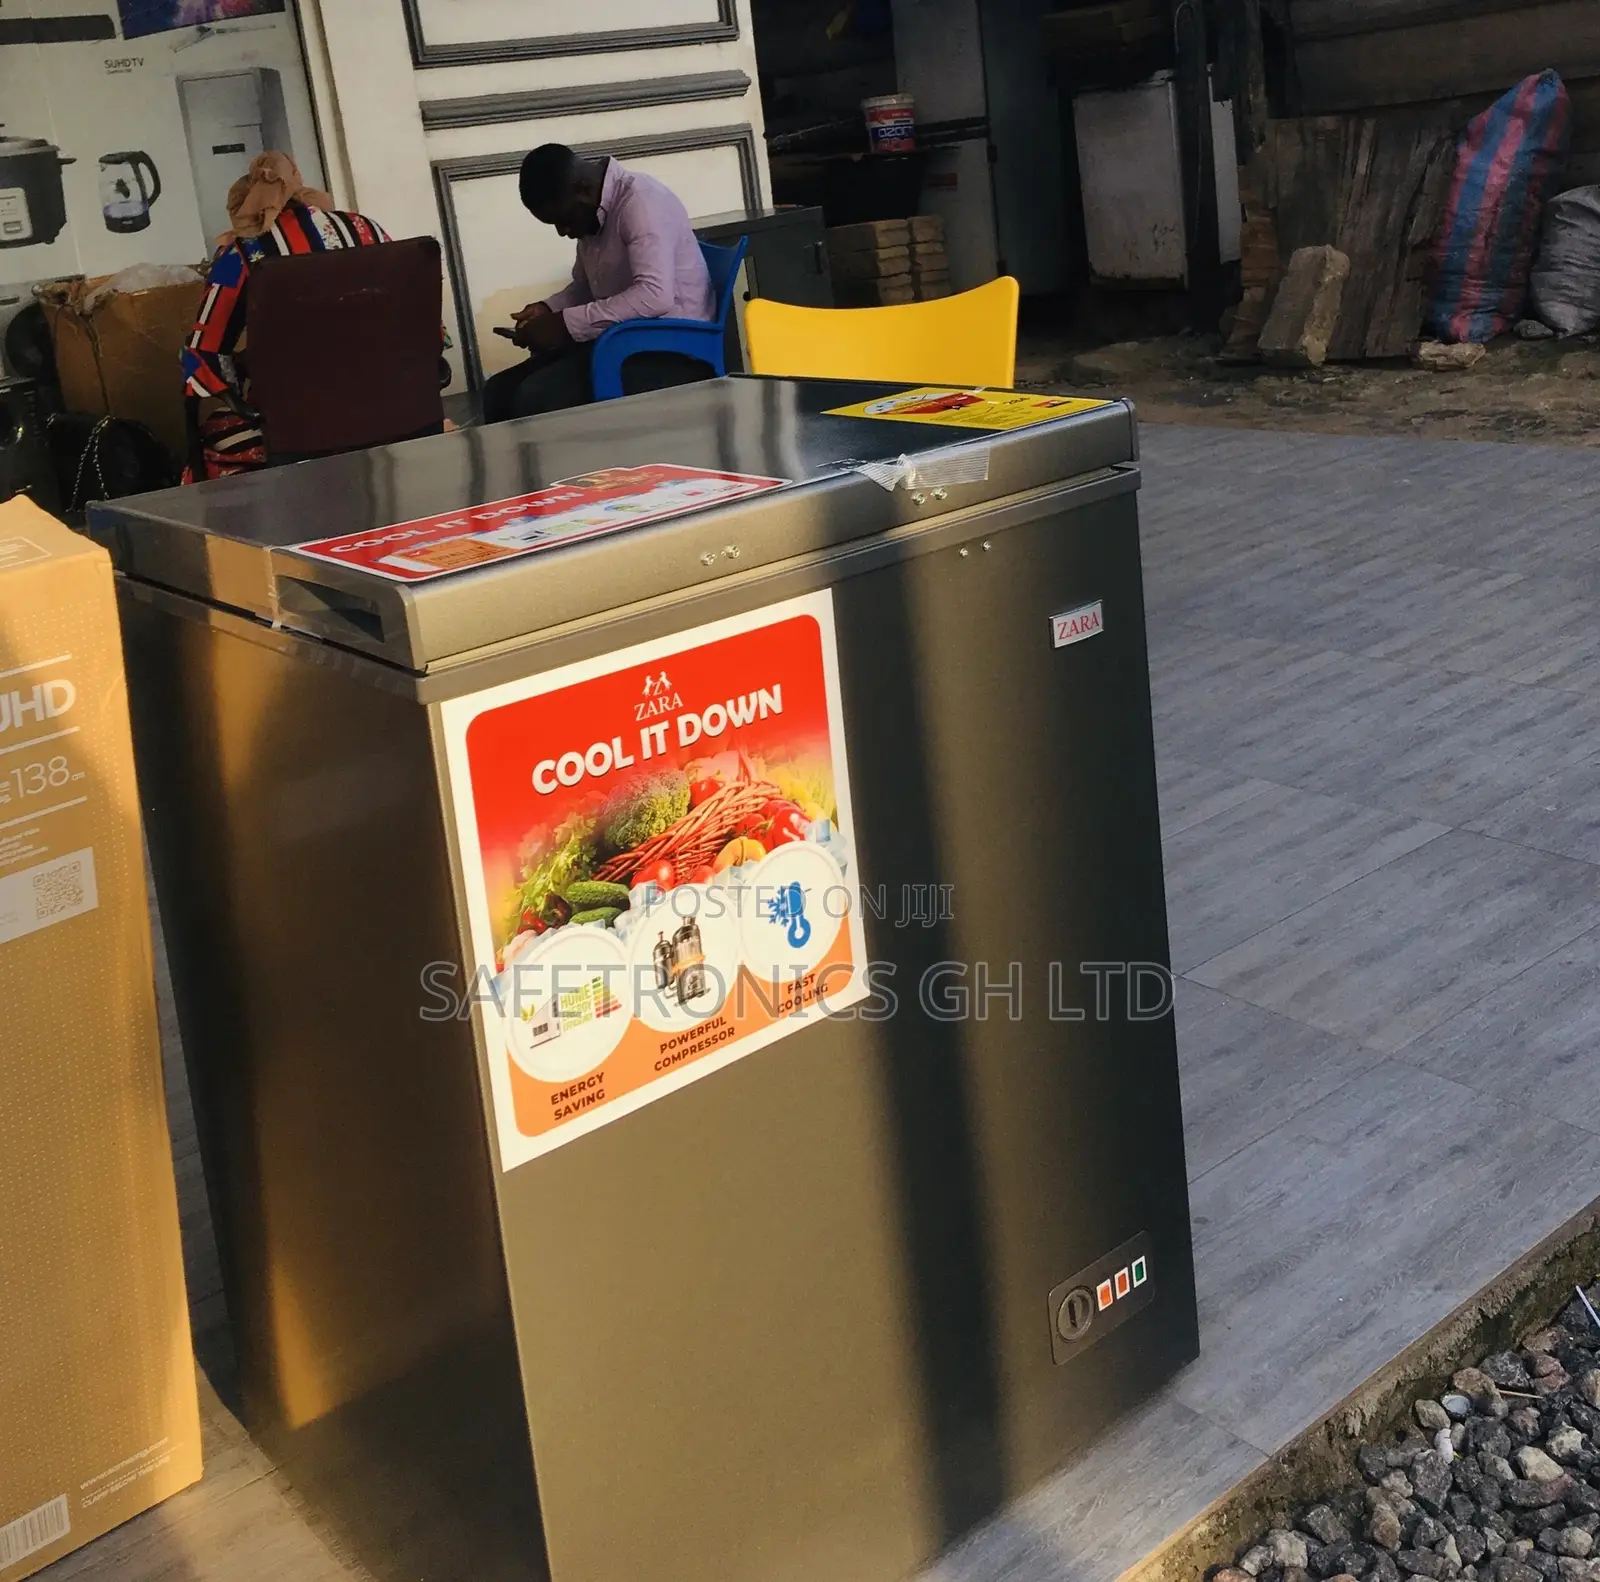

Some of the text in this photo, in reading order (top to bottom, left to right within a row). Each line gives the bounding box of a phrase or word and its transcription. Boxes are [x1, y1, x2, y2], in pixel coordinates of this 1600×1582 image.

[329, 491, 585, 553] COOL IT DOWN
[1057, 612, 1100, 640] ZARA
[634, 692, 684, 722] ZARA
[532, 683, 784, 795] COOL IT DOWN
[777, 983, 829, 1014] COOLING
[788, 973, 816, 994] FAST
[654, 1026, 736, 1072] COMPRESSOR
[659, 1016, 727, 1054] POWERFUL
[550, 1072, 605, 1106] ENERGY
[553, 1089, 606, 1121] SAVING
